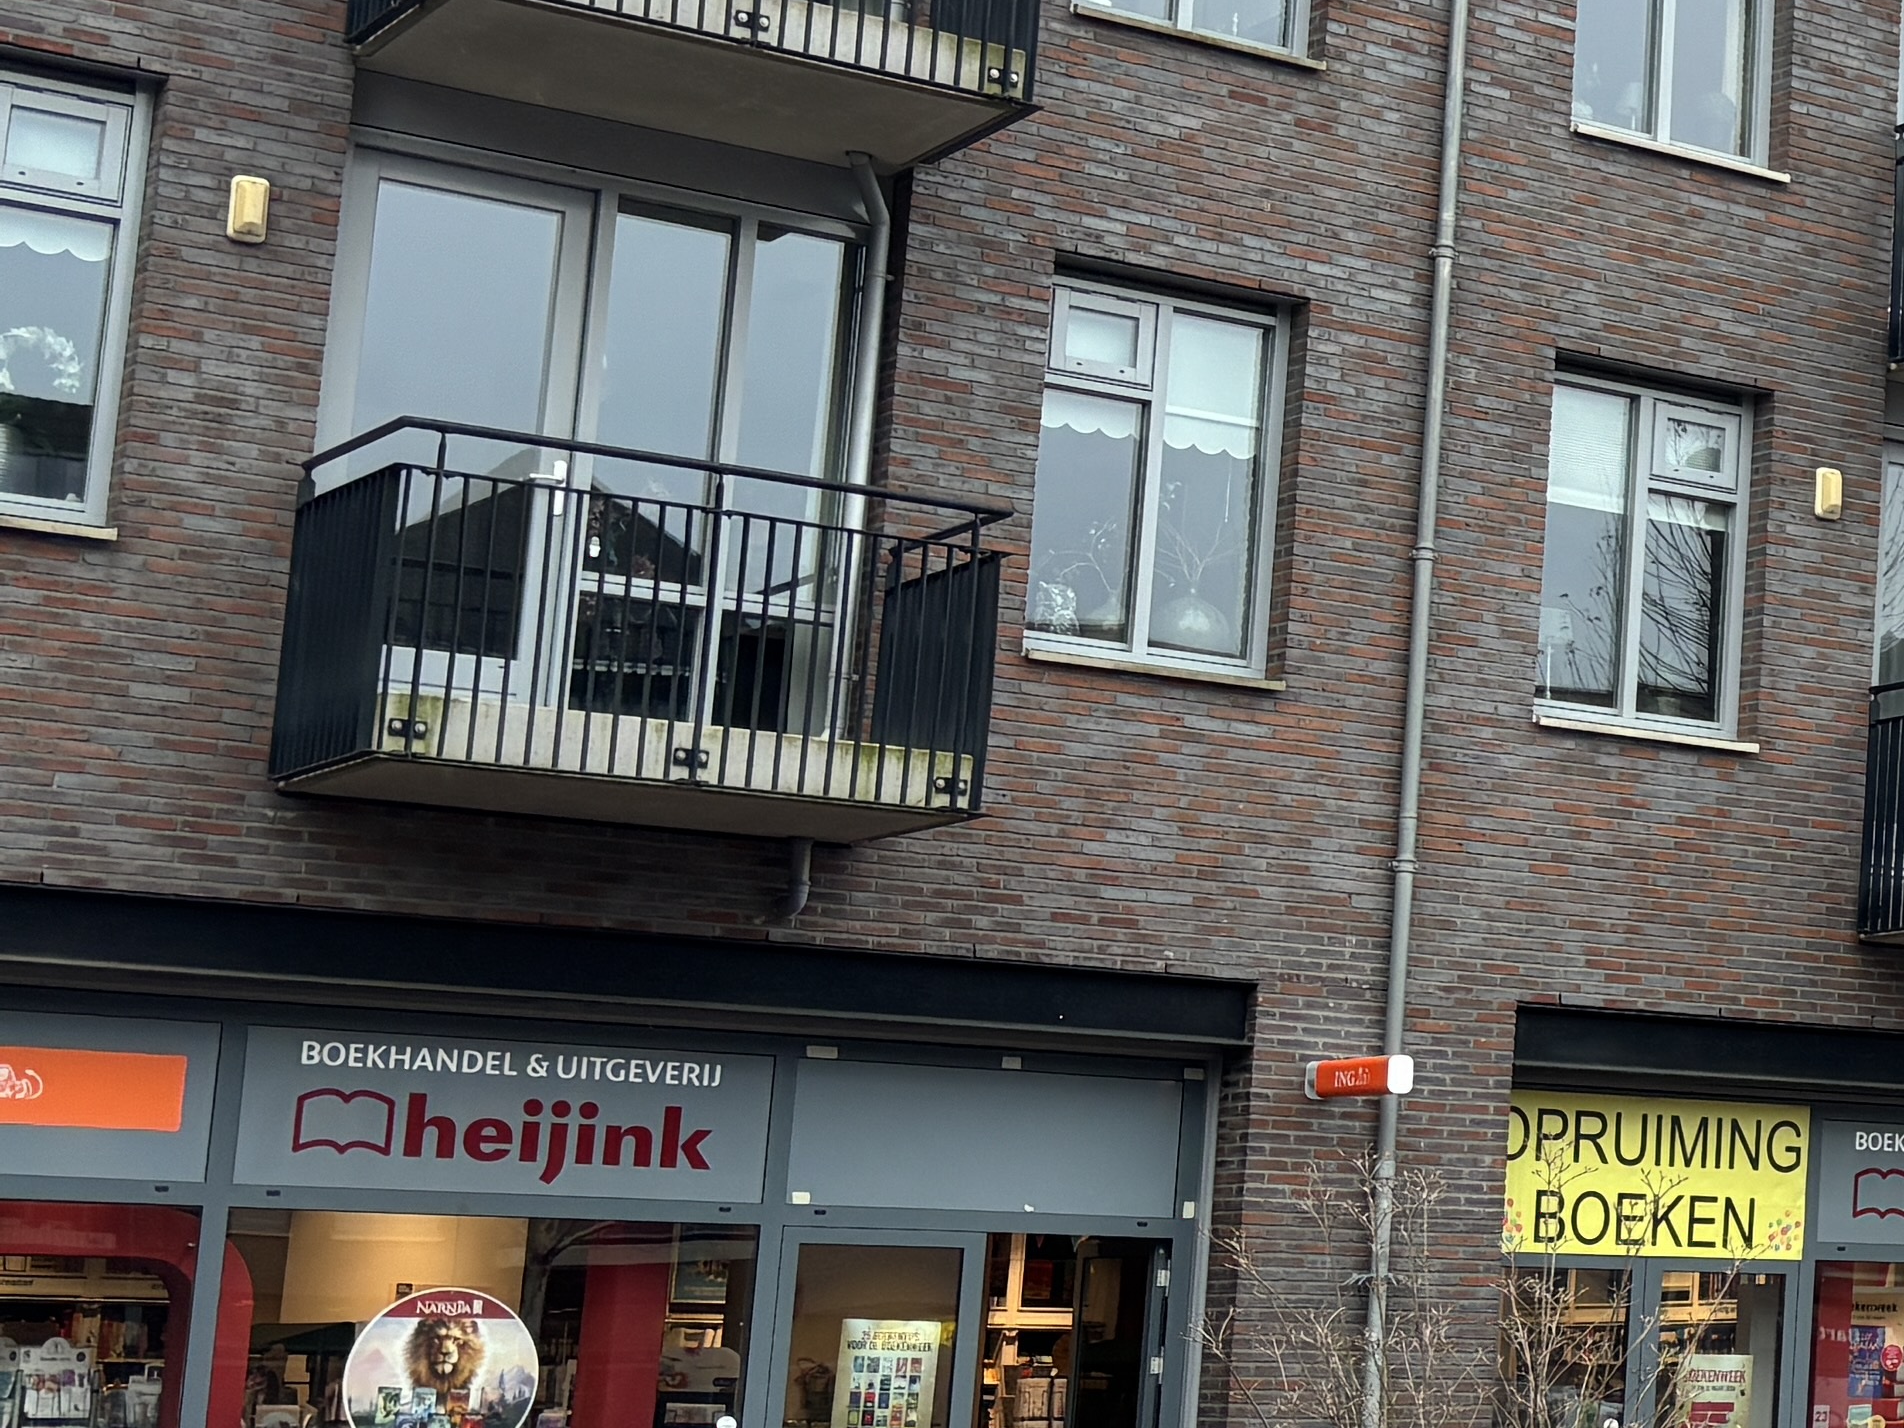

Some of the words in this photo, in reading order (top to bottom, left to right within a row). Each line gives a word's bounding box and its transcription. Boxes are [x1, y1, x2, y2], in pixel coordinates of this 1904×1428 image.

[300, 1040, 518, 1077] BOEKHANDEL
[526, 1053, 549, 1077] &
[556, 1055, 723, 1088] UITGEVERIJ
[1334, 1069, 1356, 1088] ING
[402, 1091, 713, 1185] heijink
[1506, 1105, 1802, 1174] OPRUIMING
[1533, 1189, 1755, 1250] BOEKEN
[416, 1300, 471, 1316] NARNIA
